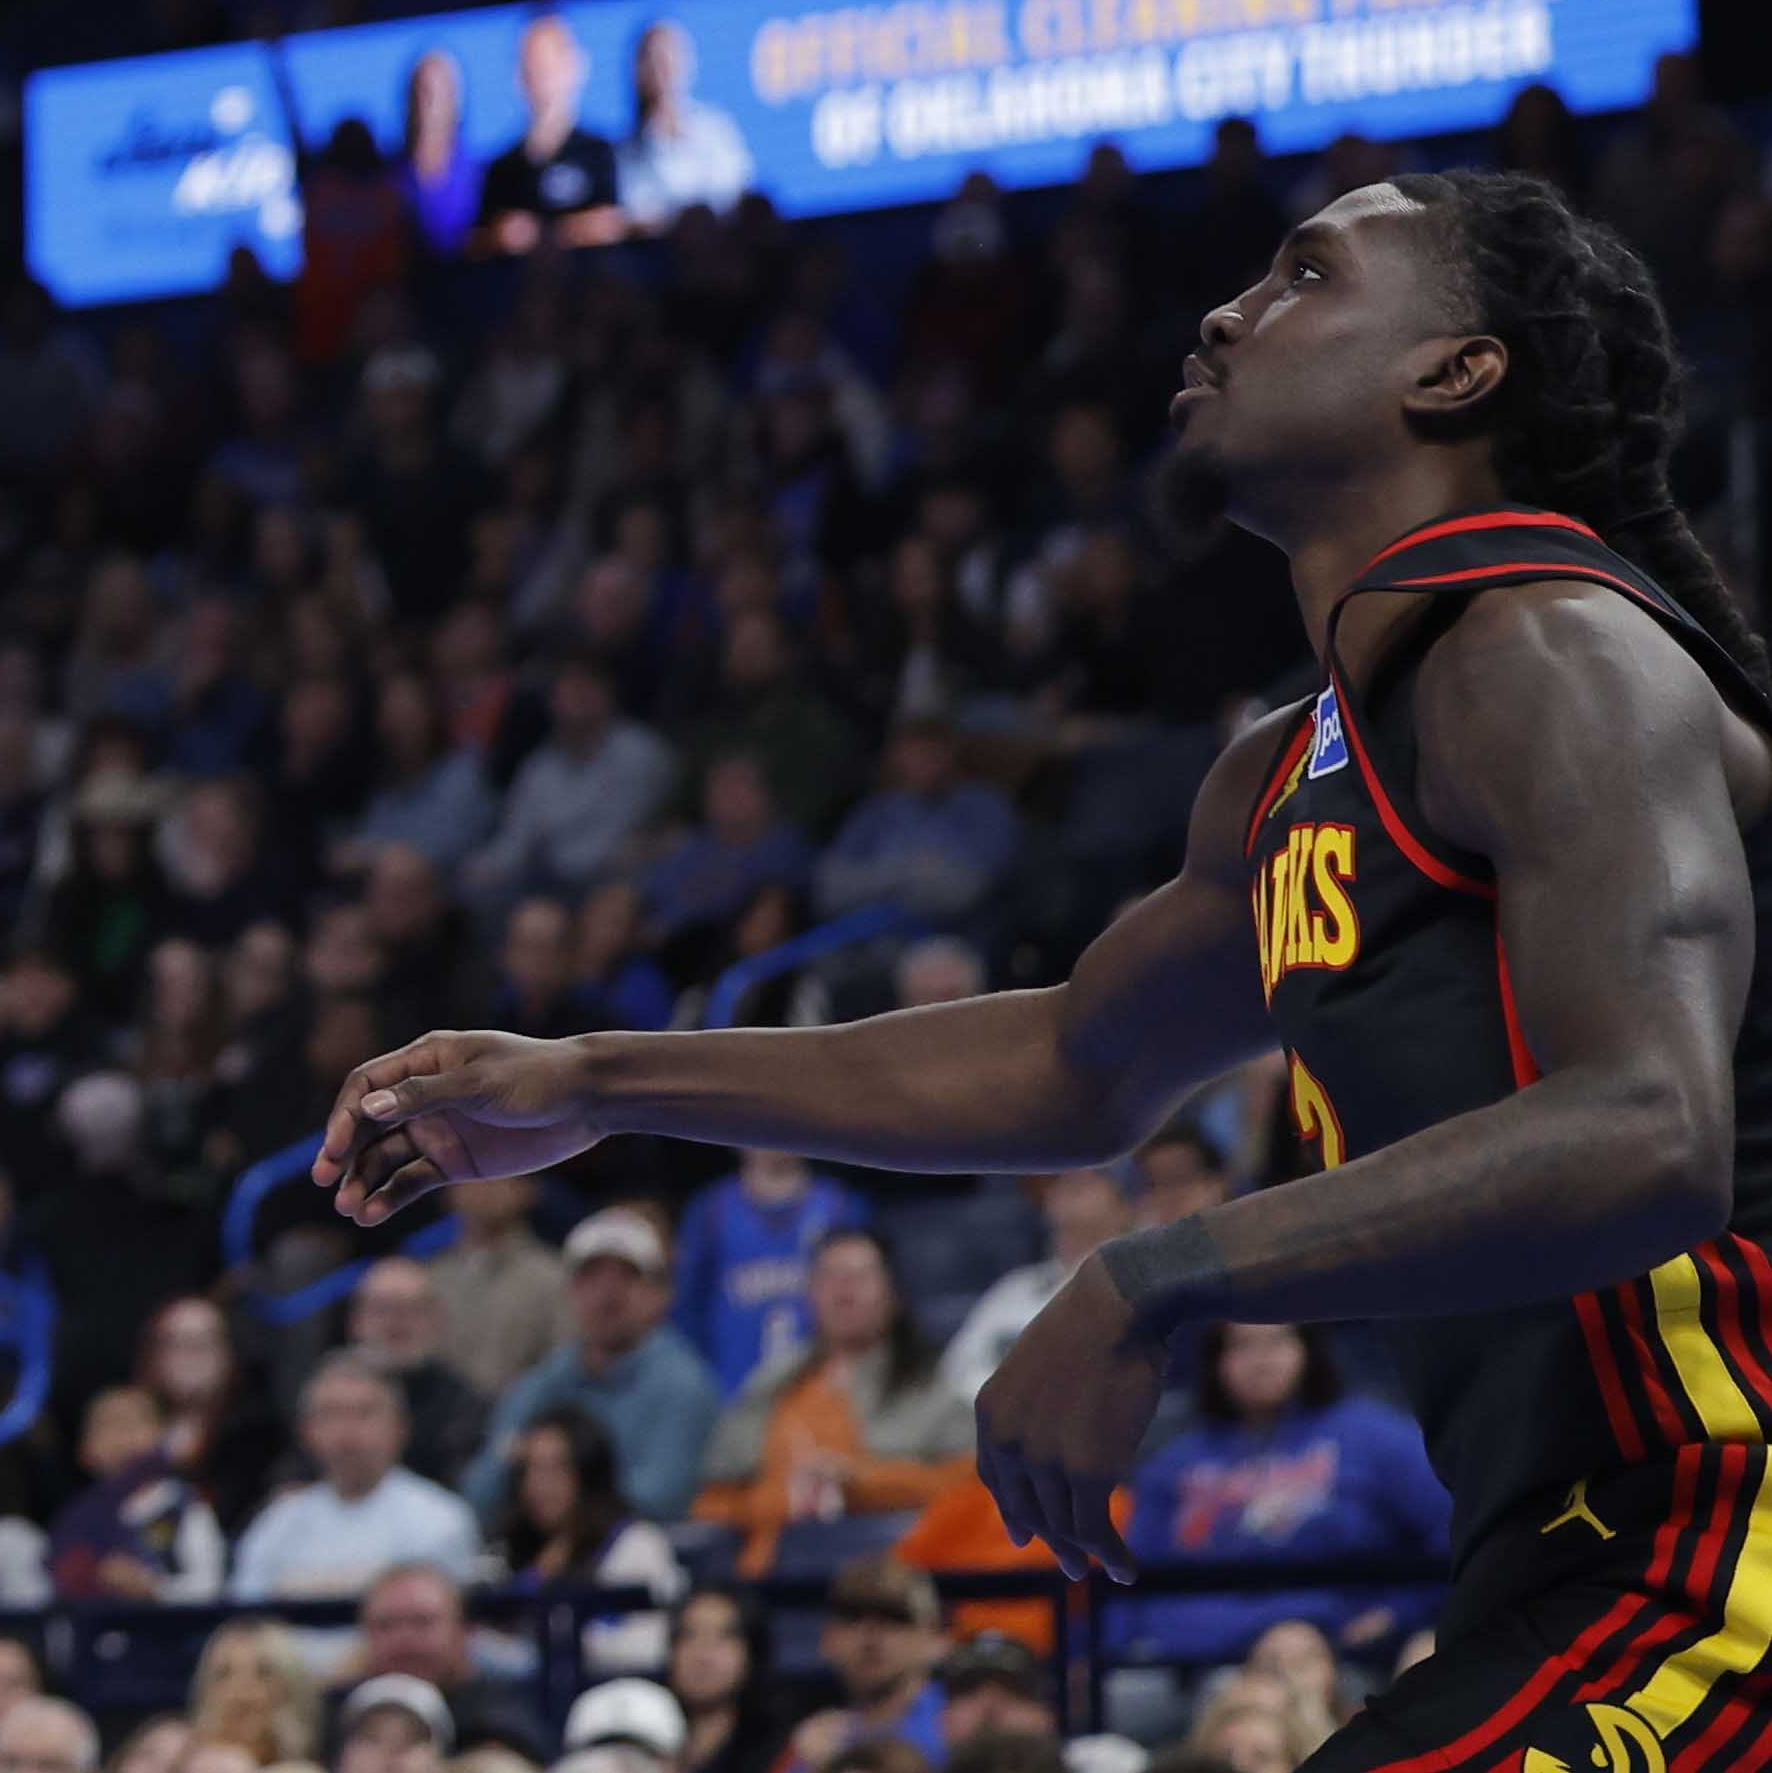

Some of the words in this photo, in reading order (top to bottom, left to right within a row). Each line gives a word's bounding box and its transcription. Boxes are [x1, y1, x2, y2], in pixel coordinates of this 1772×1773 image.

[812, 85, 883, 169] OF
[886, 48, 1171, 160] OKLAHOMA
[1175, 32, 1292, 122] CITY
